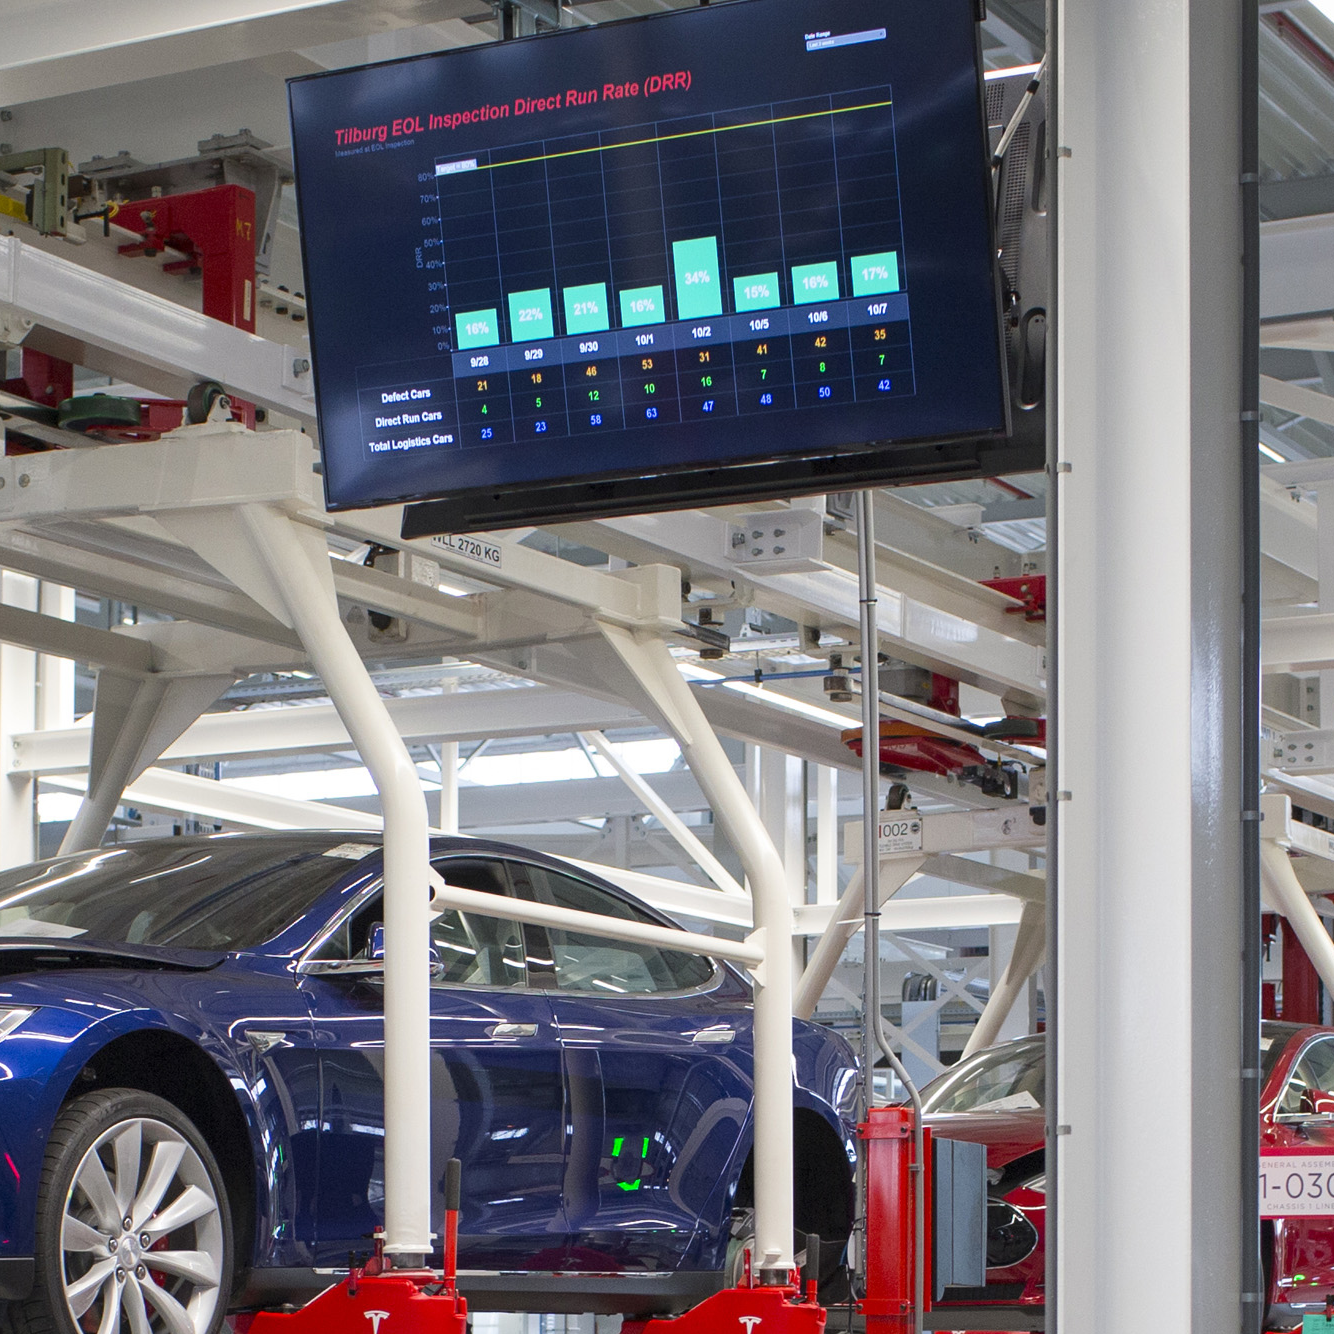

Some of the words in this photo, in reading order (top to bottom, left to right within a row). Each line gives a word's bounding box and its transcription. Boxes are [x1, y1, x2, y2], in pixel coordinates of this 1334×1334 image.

[335, 122, 388, 146] Tilburg
[392, 116, 424, 136] EOL
[428, 103, 509, 131] Inspection
[514, 94, 560, 116] Direct
[566, 87, 598, 107] Run
[603, 80, 639, 101] Rate
[644, 70, 692, 98] (DRR)
[334, 148, 364, 158] Measured
[371, 144, 384, 152] EOL
[385, 140, 415, 150] Inspection
[418, 173, 434, 182] 80%
[420, 195, 436, 204] 70%
[422, 217, 438, 226] 60%
[424, 239, 440, 248] 50%
[415, 247, 424, 268] DRR
[426, 261, 442, 269] 40%
[685, 270, 710, 285] 34%
[862, 266, 888, 281] 17%
[428, 283, 444, 291] 30%
[803, 275, 828, 290] 16%
[744, 284, 769, 300] 15%
[430, 304, 446, 314] 20%
[574, 302, 598, 316] 21%
[630, 298, 654, 313] 16%
[518, 308, 543, 322] 22%
[432, 326, 448, 335] 10%
[466, 322, 489, 336] 16%
[470, 356, 489, 368] 9/28
[524, 349, 543, 360] 9/29
[579, 341, 598, 354] 9/30
[636, 334, 654, 346] 10/1
[692, 326, 711, 339] 10/2
[750, 318, 769, 331] 10/5
[808, 311, 828, 323] 10/6
[868, 303, 888, 316] 10/7
[438, 342, 450, 350] 0%
[382, 391, 409, 404] Defect
[410, 389, 431, 400] Cars
[477, 380, 488, 391] 21
[531, 373, 542, 384] 18
[586, 366, 597, 377] 46
[642, 358, 653, 370] 53
[699, 352, 710, 362] 31
[757, 344, 768, 355] 41
[815, 336, 826, 348] 42
[874, 329, 886, 340] 35
[375, 415, 401, 428] Direct
[403, 413, 420, 424] Run
[422, 411, 442, 422] Cars
[481, 404, 487, 415] 4
[536, 398, 542, 407] 5
[589, 390, 599, 401] 12
[644, 384, 655, 394] 10
[701, 376, 712, 387] 16
[761, 369, 767, 380] 7
[820, 362, 826, 373] 8
[879, 354, 885, 365] 7
[369, 440, 390, 452] Total
[392, 436, 431, 450] Logistics
[433, 434, 453, 445] Cars
[481, 428, 492, 439] 25
[536, 422, 547, 432] 23
[590, 414, 602, 425] 58
[646, 408, 657, 418] 63
[703, 401, 714, 412] 47
[760, 394, 772, 404] 48
[819, 386, 831, 398] 50
[878, 380, 890, 391] 42
[458, 538, 481, 556] 2720
[484, 547, 500, 562] KG
[883, 823, 908, 837] 002
